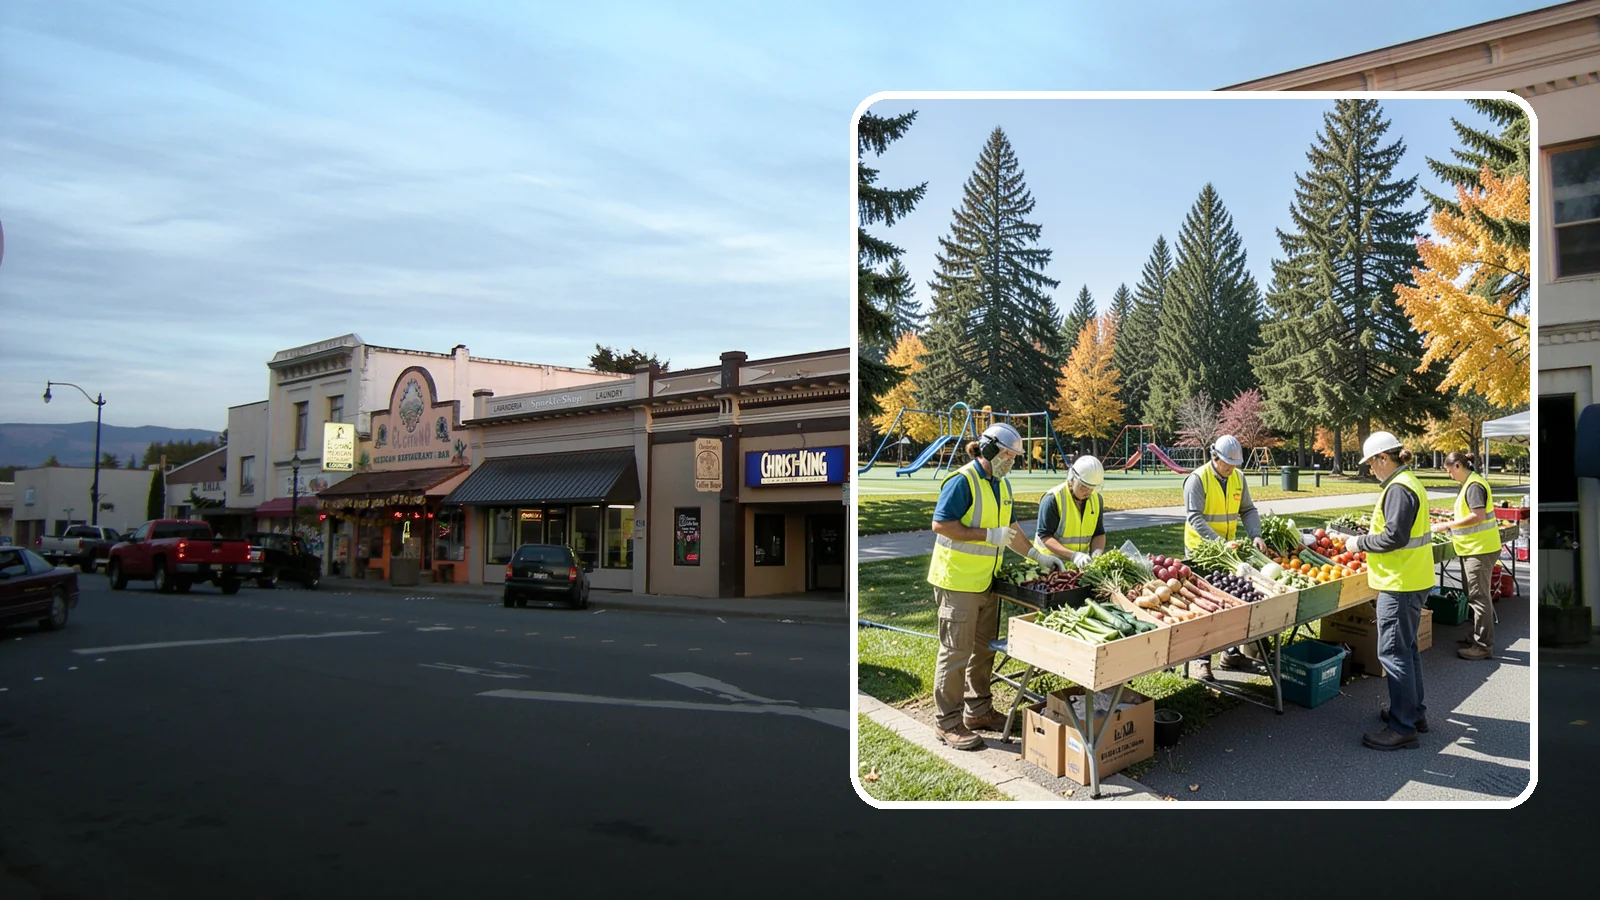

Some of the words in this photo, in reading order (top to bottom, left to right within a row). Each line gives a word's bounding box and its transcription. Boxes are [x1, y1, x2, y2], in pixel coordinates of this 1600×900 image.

[595, 389, 623, 400] LAUNDRY
[493, 402, 522, 412] LAVANDERIA
[531, 396, 561, 409] Sparkle
[562, 394, 582, 404] Shop
[373, 455, 396, 464] MEXICAN
[398, 451, 433, 462] RESTAURANT
[437, 450, 450, 459] BAR
